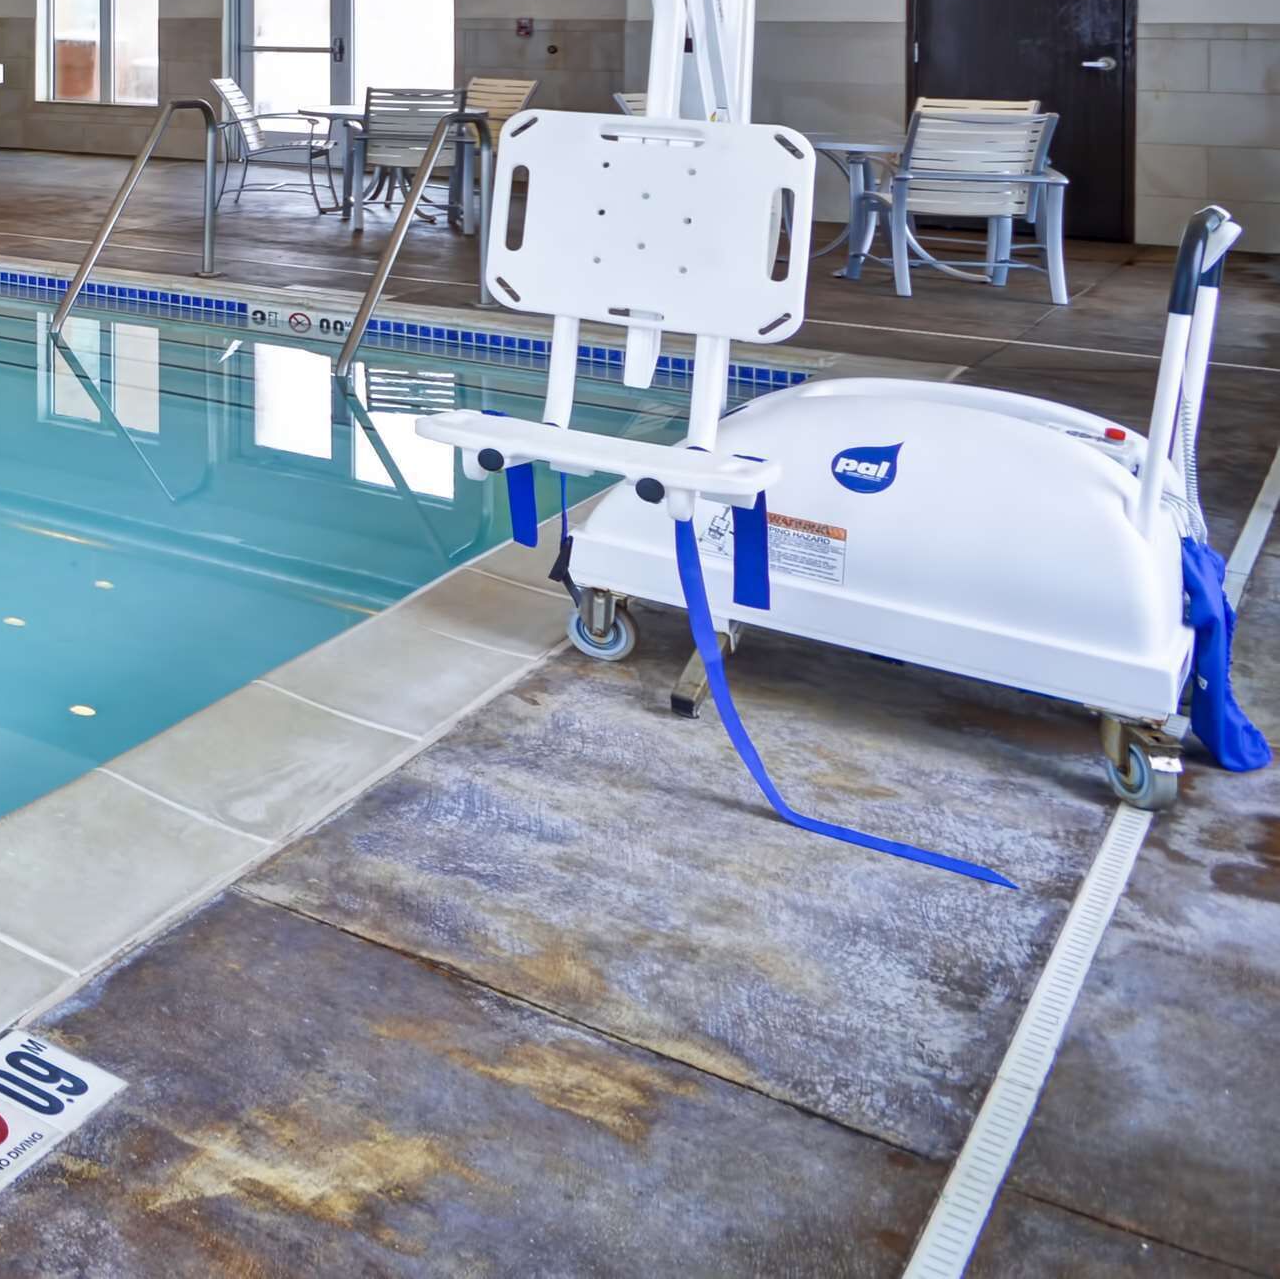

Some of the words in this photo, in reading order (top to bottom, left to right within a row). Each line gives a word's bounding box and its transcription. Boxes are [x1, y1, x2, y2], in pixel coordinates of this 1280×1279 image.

[793, 532, 831, 545] HAZARD
[21, 1038, 48, 1056] M
[10, 1132, 44, 1162] DIVING
